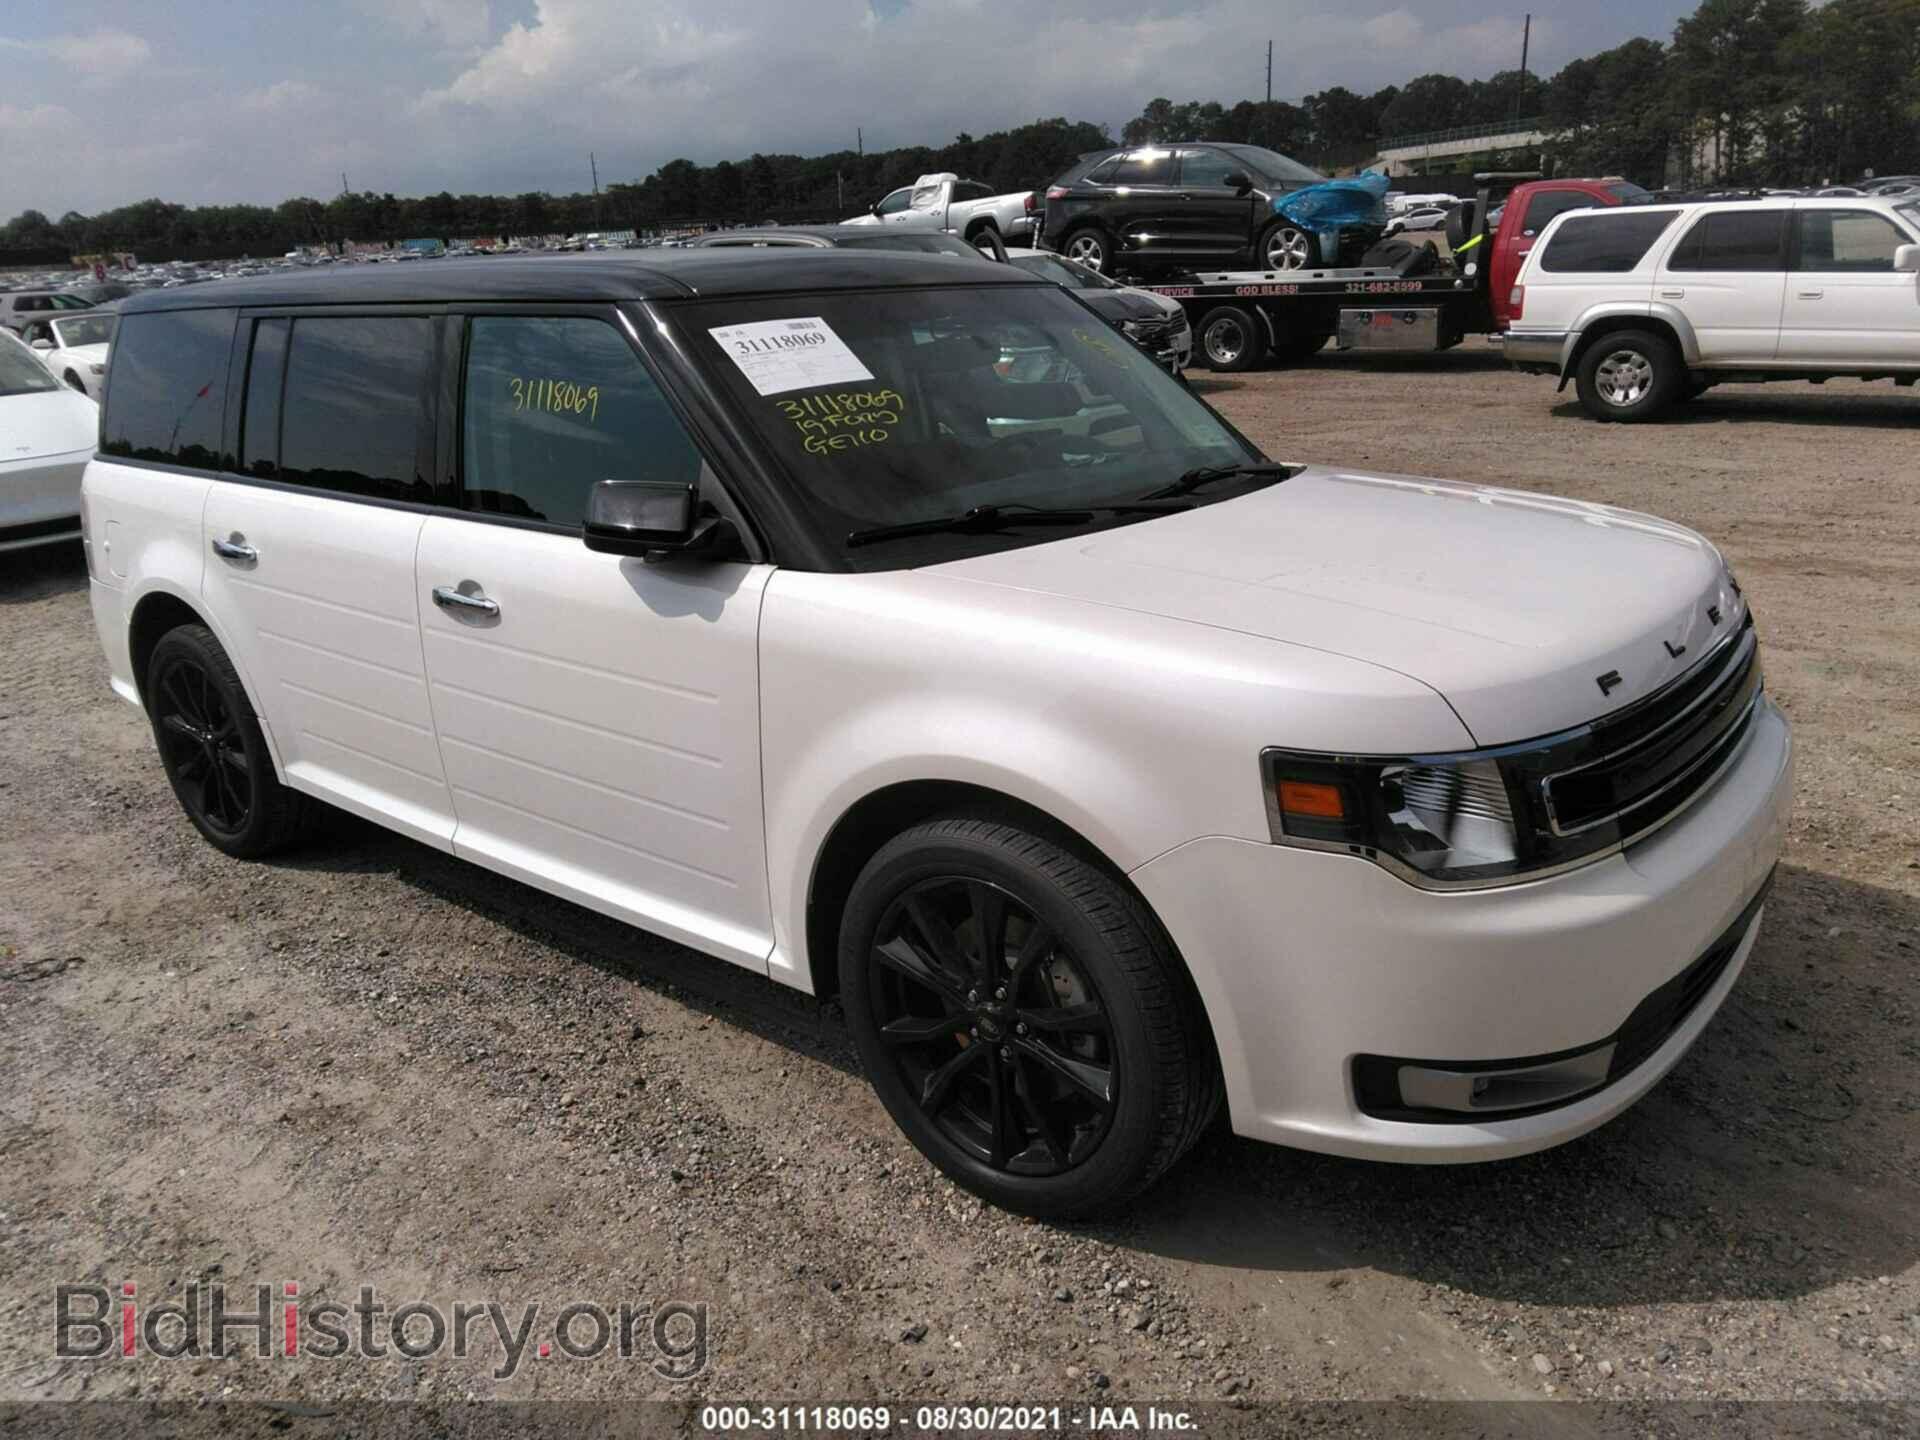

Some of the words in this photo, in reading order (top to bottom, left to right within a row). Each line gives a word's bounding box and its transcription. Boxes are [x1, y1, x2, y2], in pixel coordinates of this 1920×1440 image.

[1153, 287, 1195, 297] SERVICE
[1235, 286, 1257, 296] GOD
[735, 332, 826, 354] 31118069
[511, 378, 599, 423] 31118069
[775, 389, 904, 420] 31118069
[804, 429, 889, 455] GEICO
